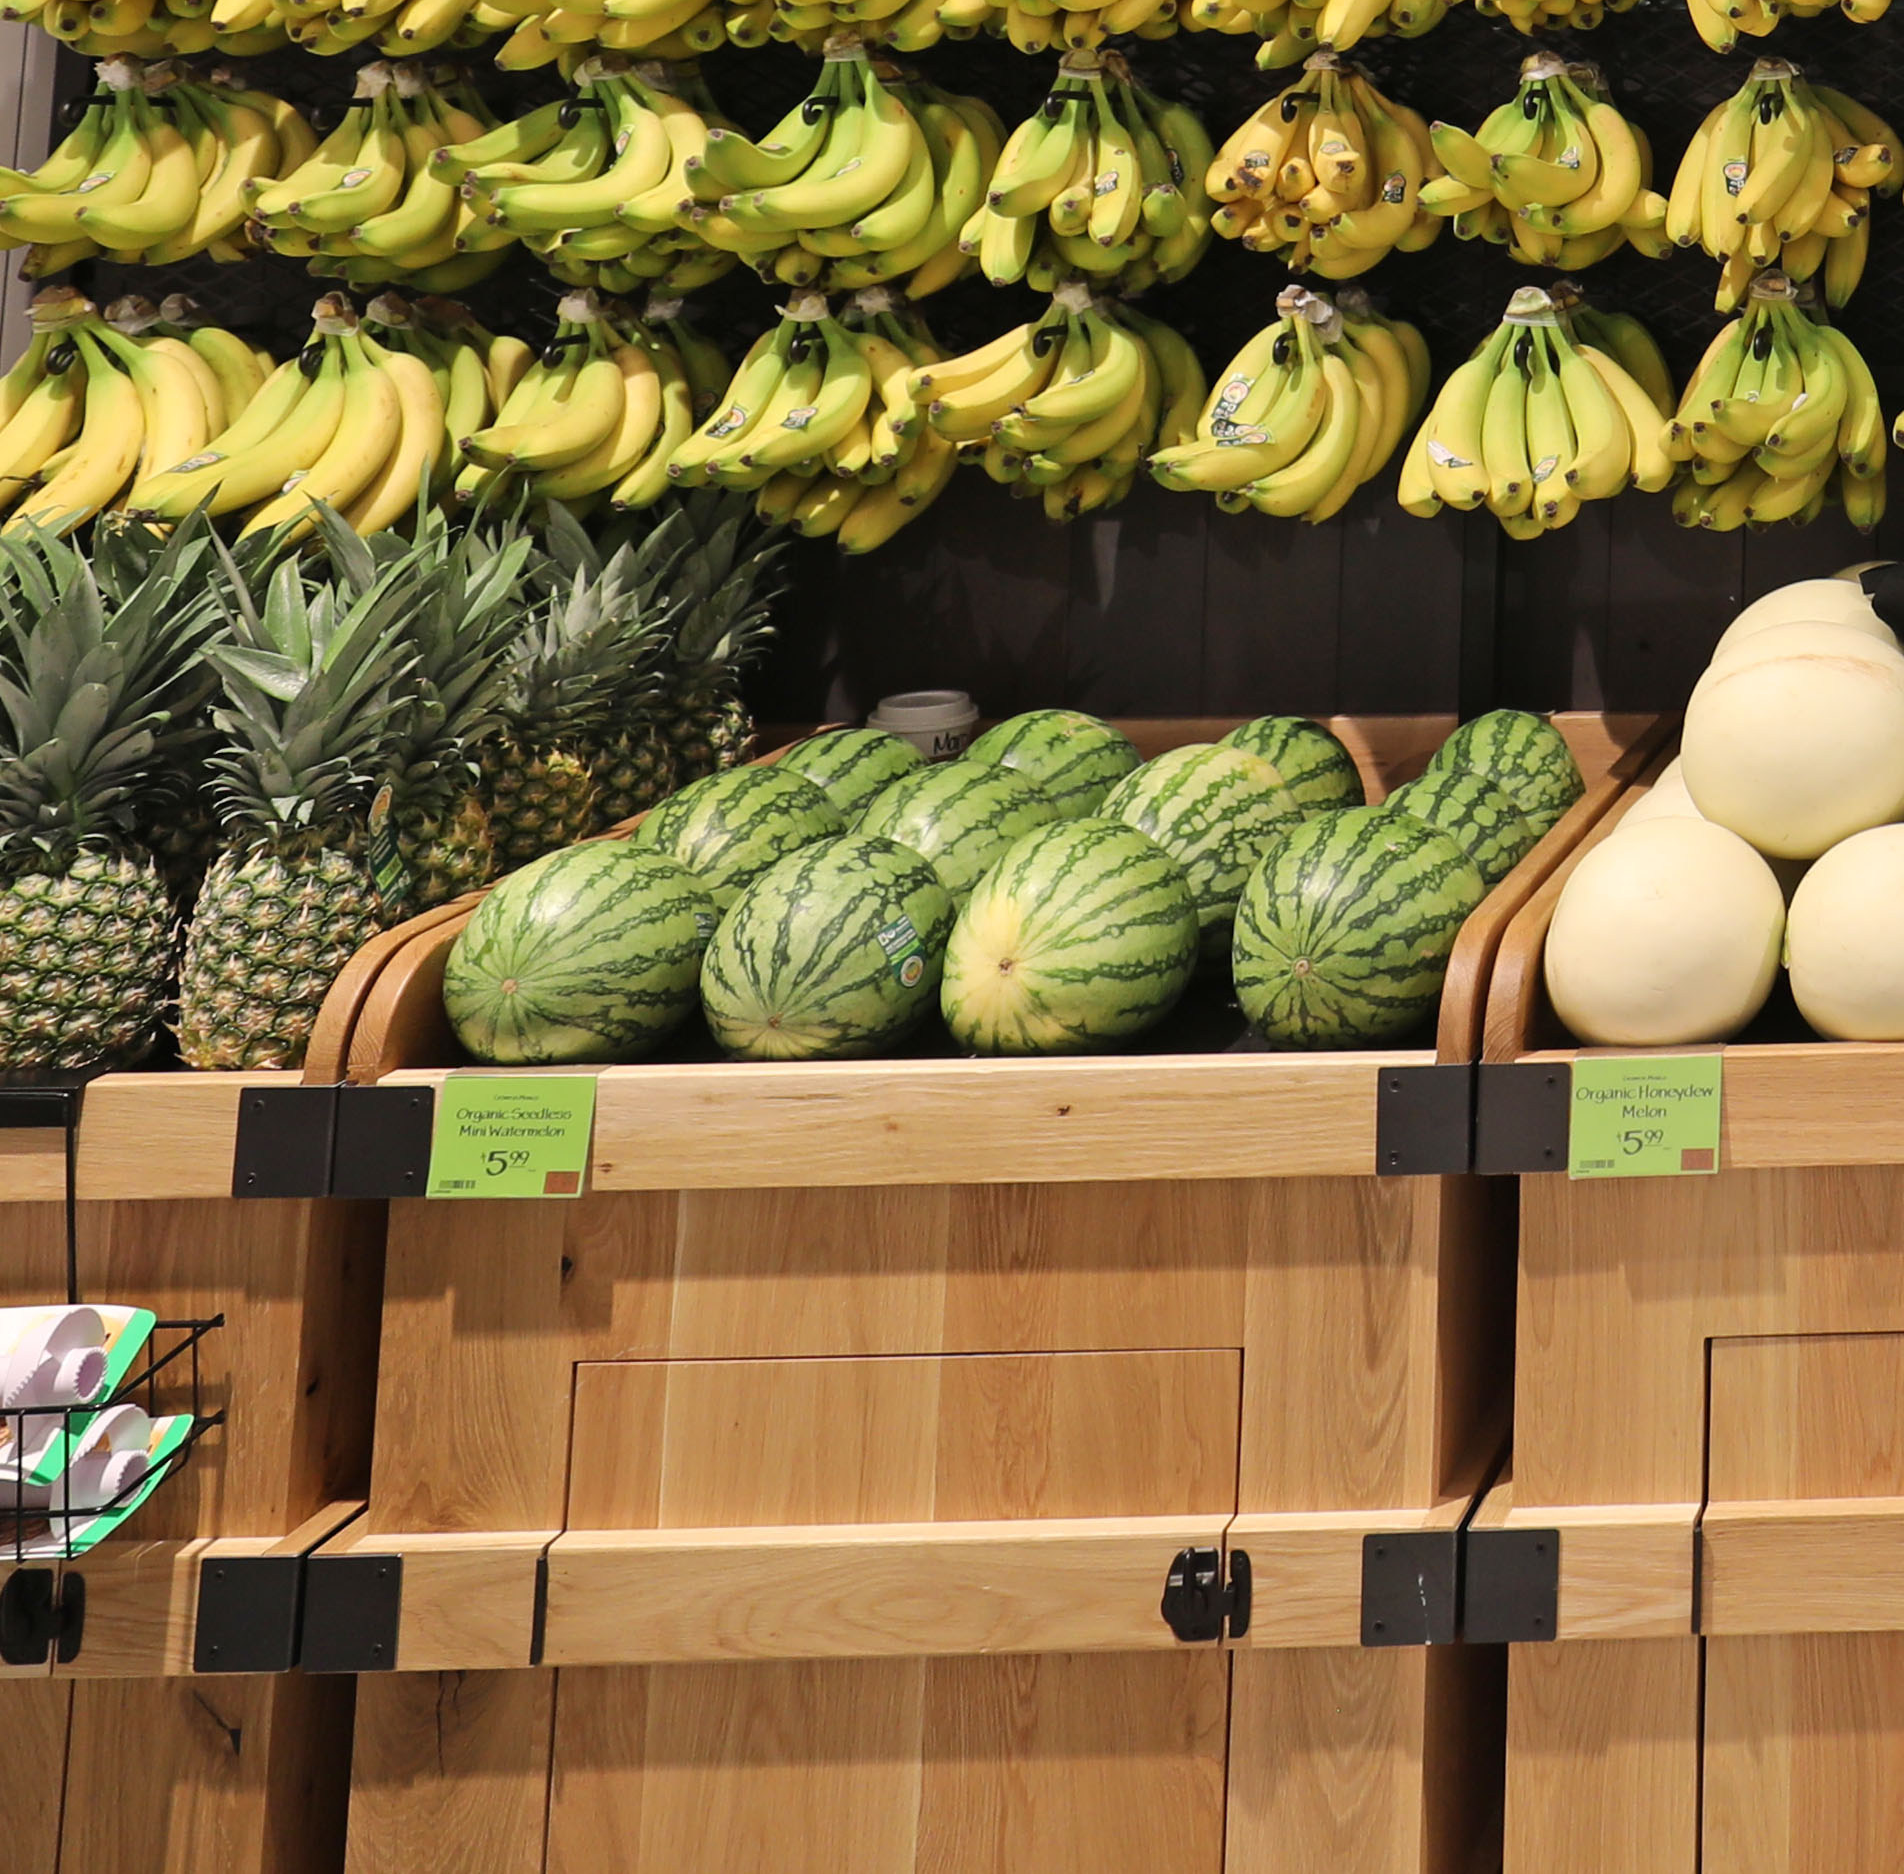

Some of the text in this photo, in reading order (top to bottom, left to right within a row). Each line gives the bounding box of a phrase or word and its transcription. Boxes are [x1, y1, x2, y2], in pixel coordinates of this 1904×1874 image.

[1575, 1084, 1714, 1104] Organic Honeydew
[456, 1107, 573, 1123] Organic Seedless
[1622, 1105, 1667, 1119] Melon
[459, 1125, 566, 1137] Mini Watermelon
